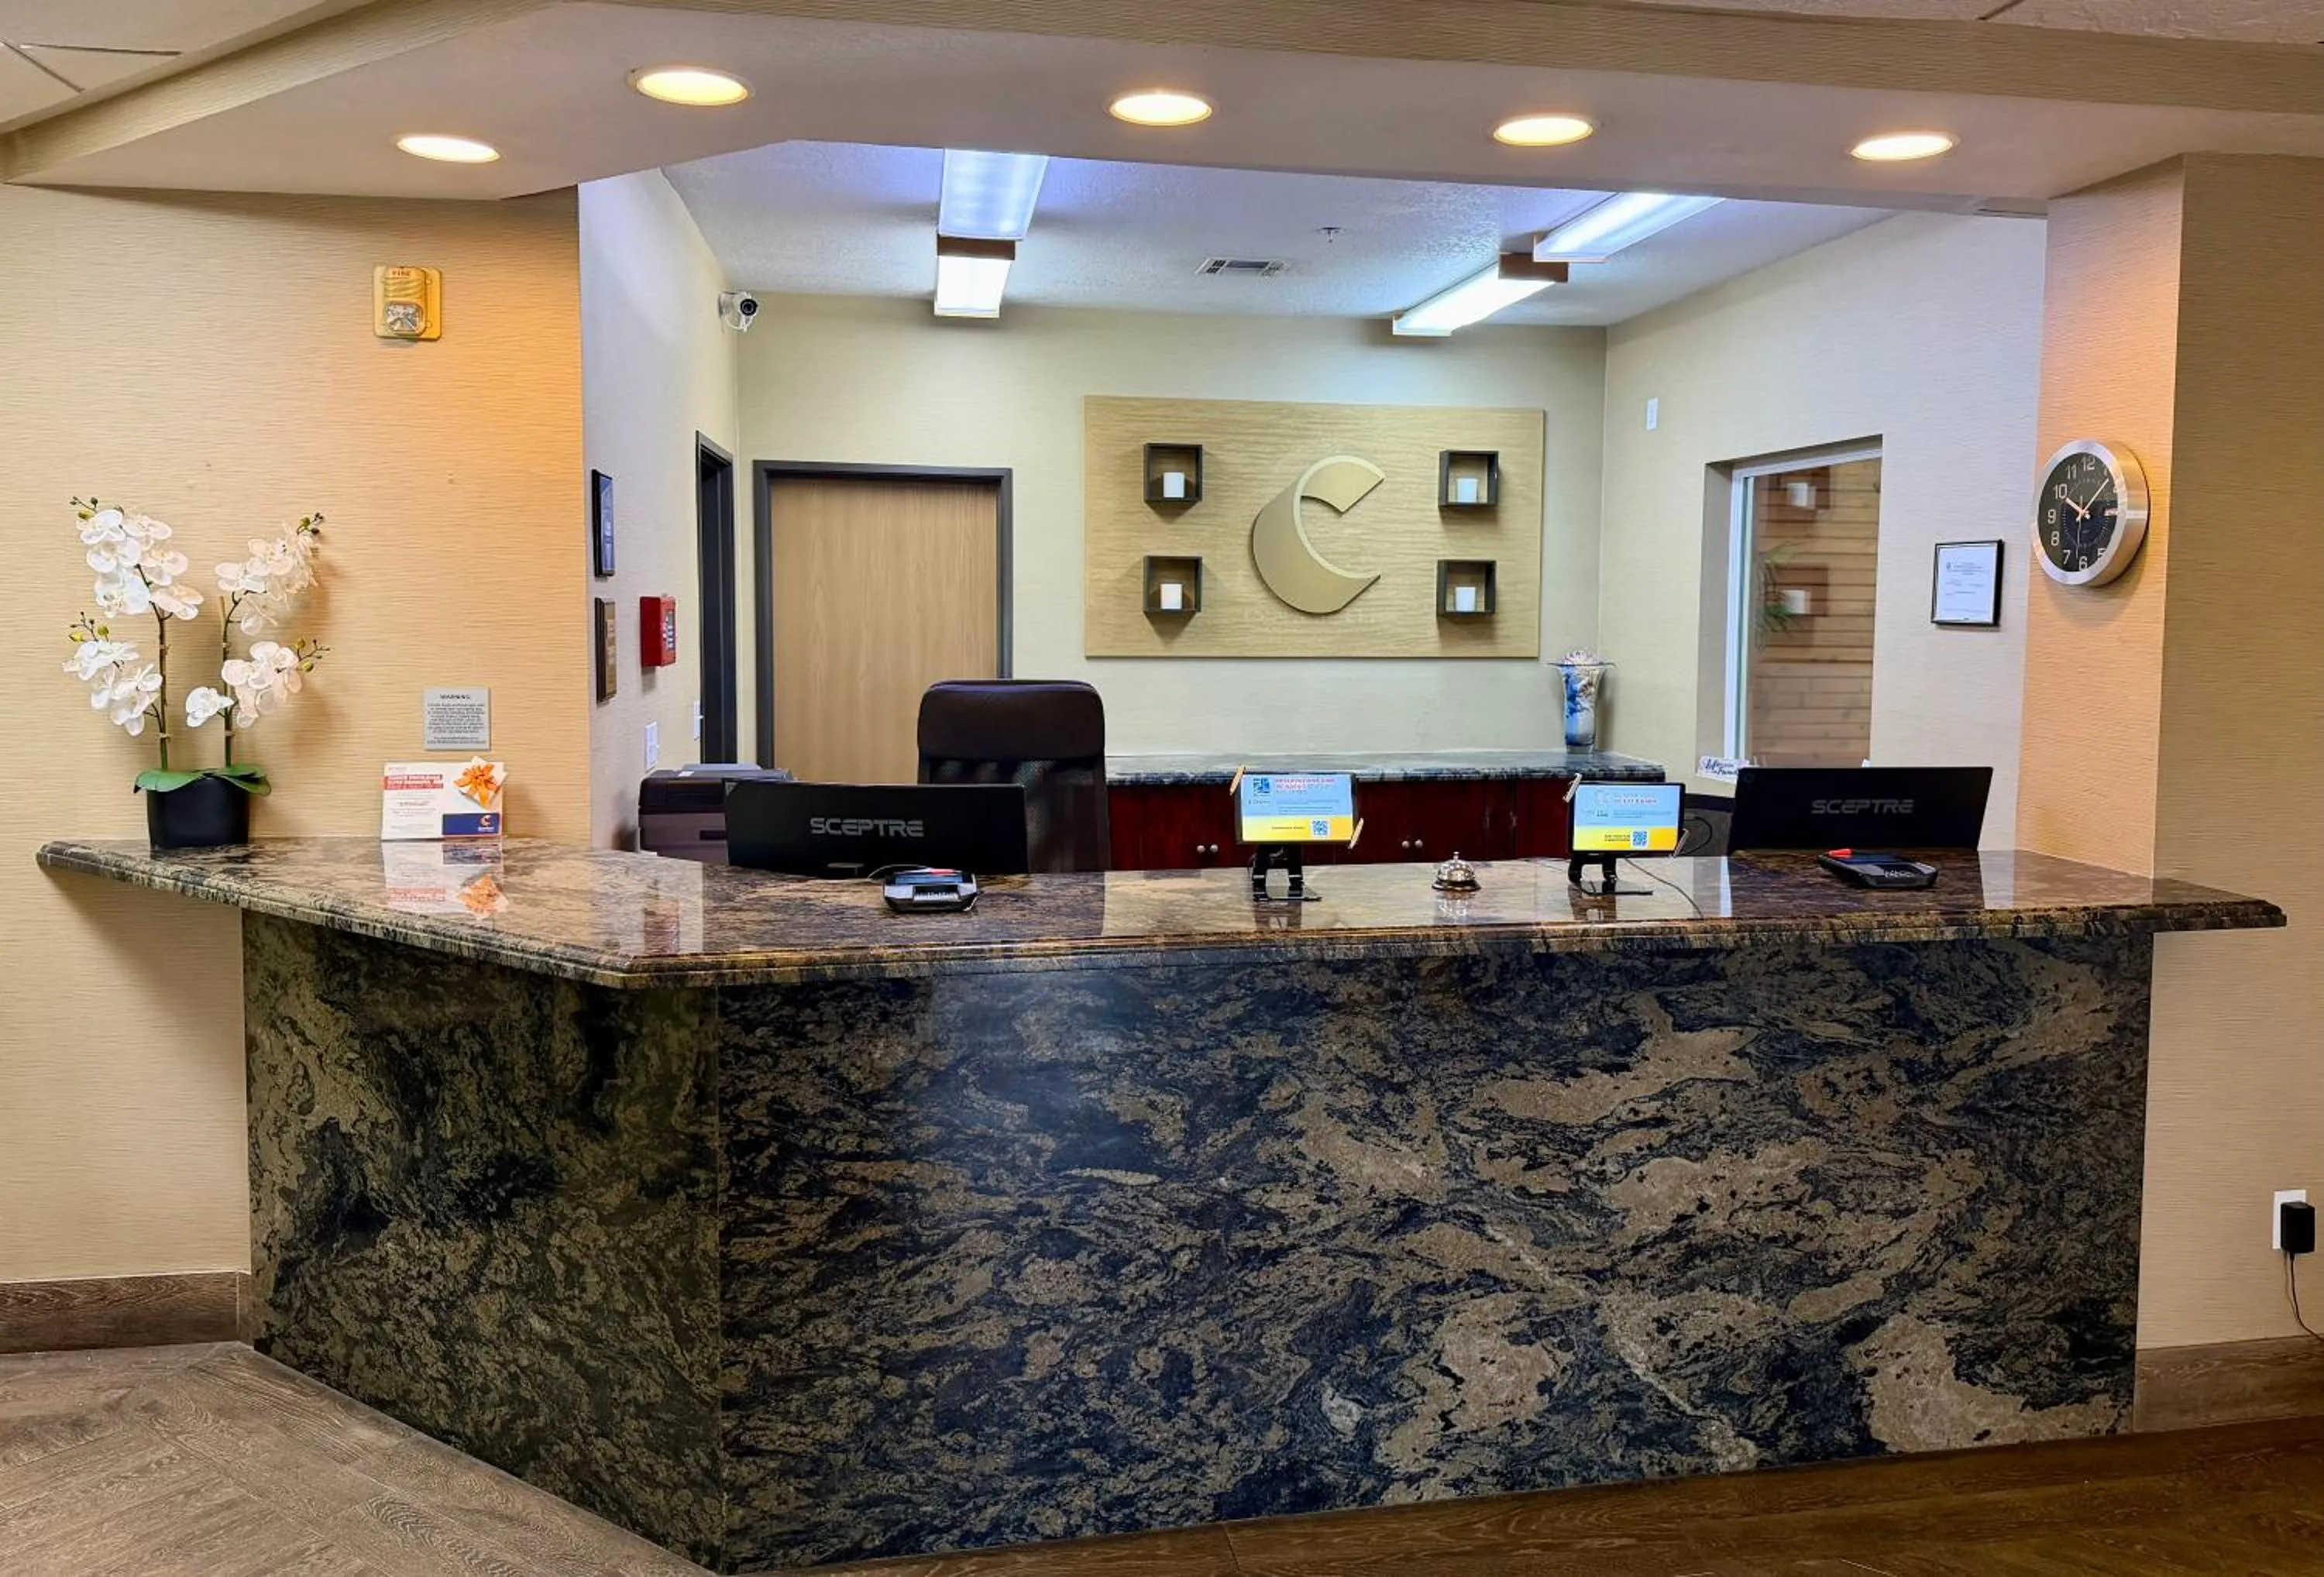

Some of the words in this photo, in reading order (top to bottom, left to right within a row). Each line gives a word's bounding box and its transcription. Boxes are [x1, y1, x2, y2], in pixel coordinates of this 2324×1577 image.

[2065, 464, 2077, 479] 11
[2082, 456, 2095, 472] 12
[2053, 483, 2068, 500] 10
[2047, 509, 2057, 524] 9
[2051, 531, 2060, 547] 8
[2063, 549, 2071, 565] 7
[2078, 555, 2088, 572] 6
[1811, 799, 1914, 814] SCEPTRE
[810, 817, 924, 837] SCEPTRE
